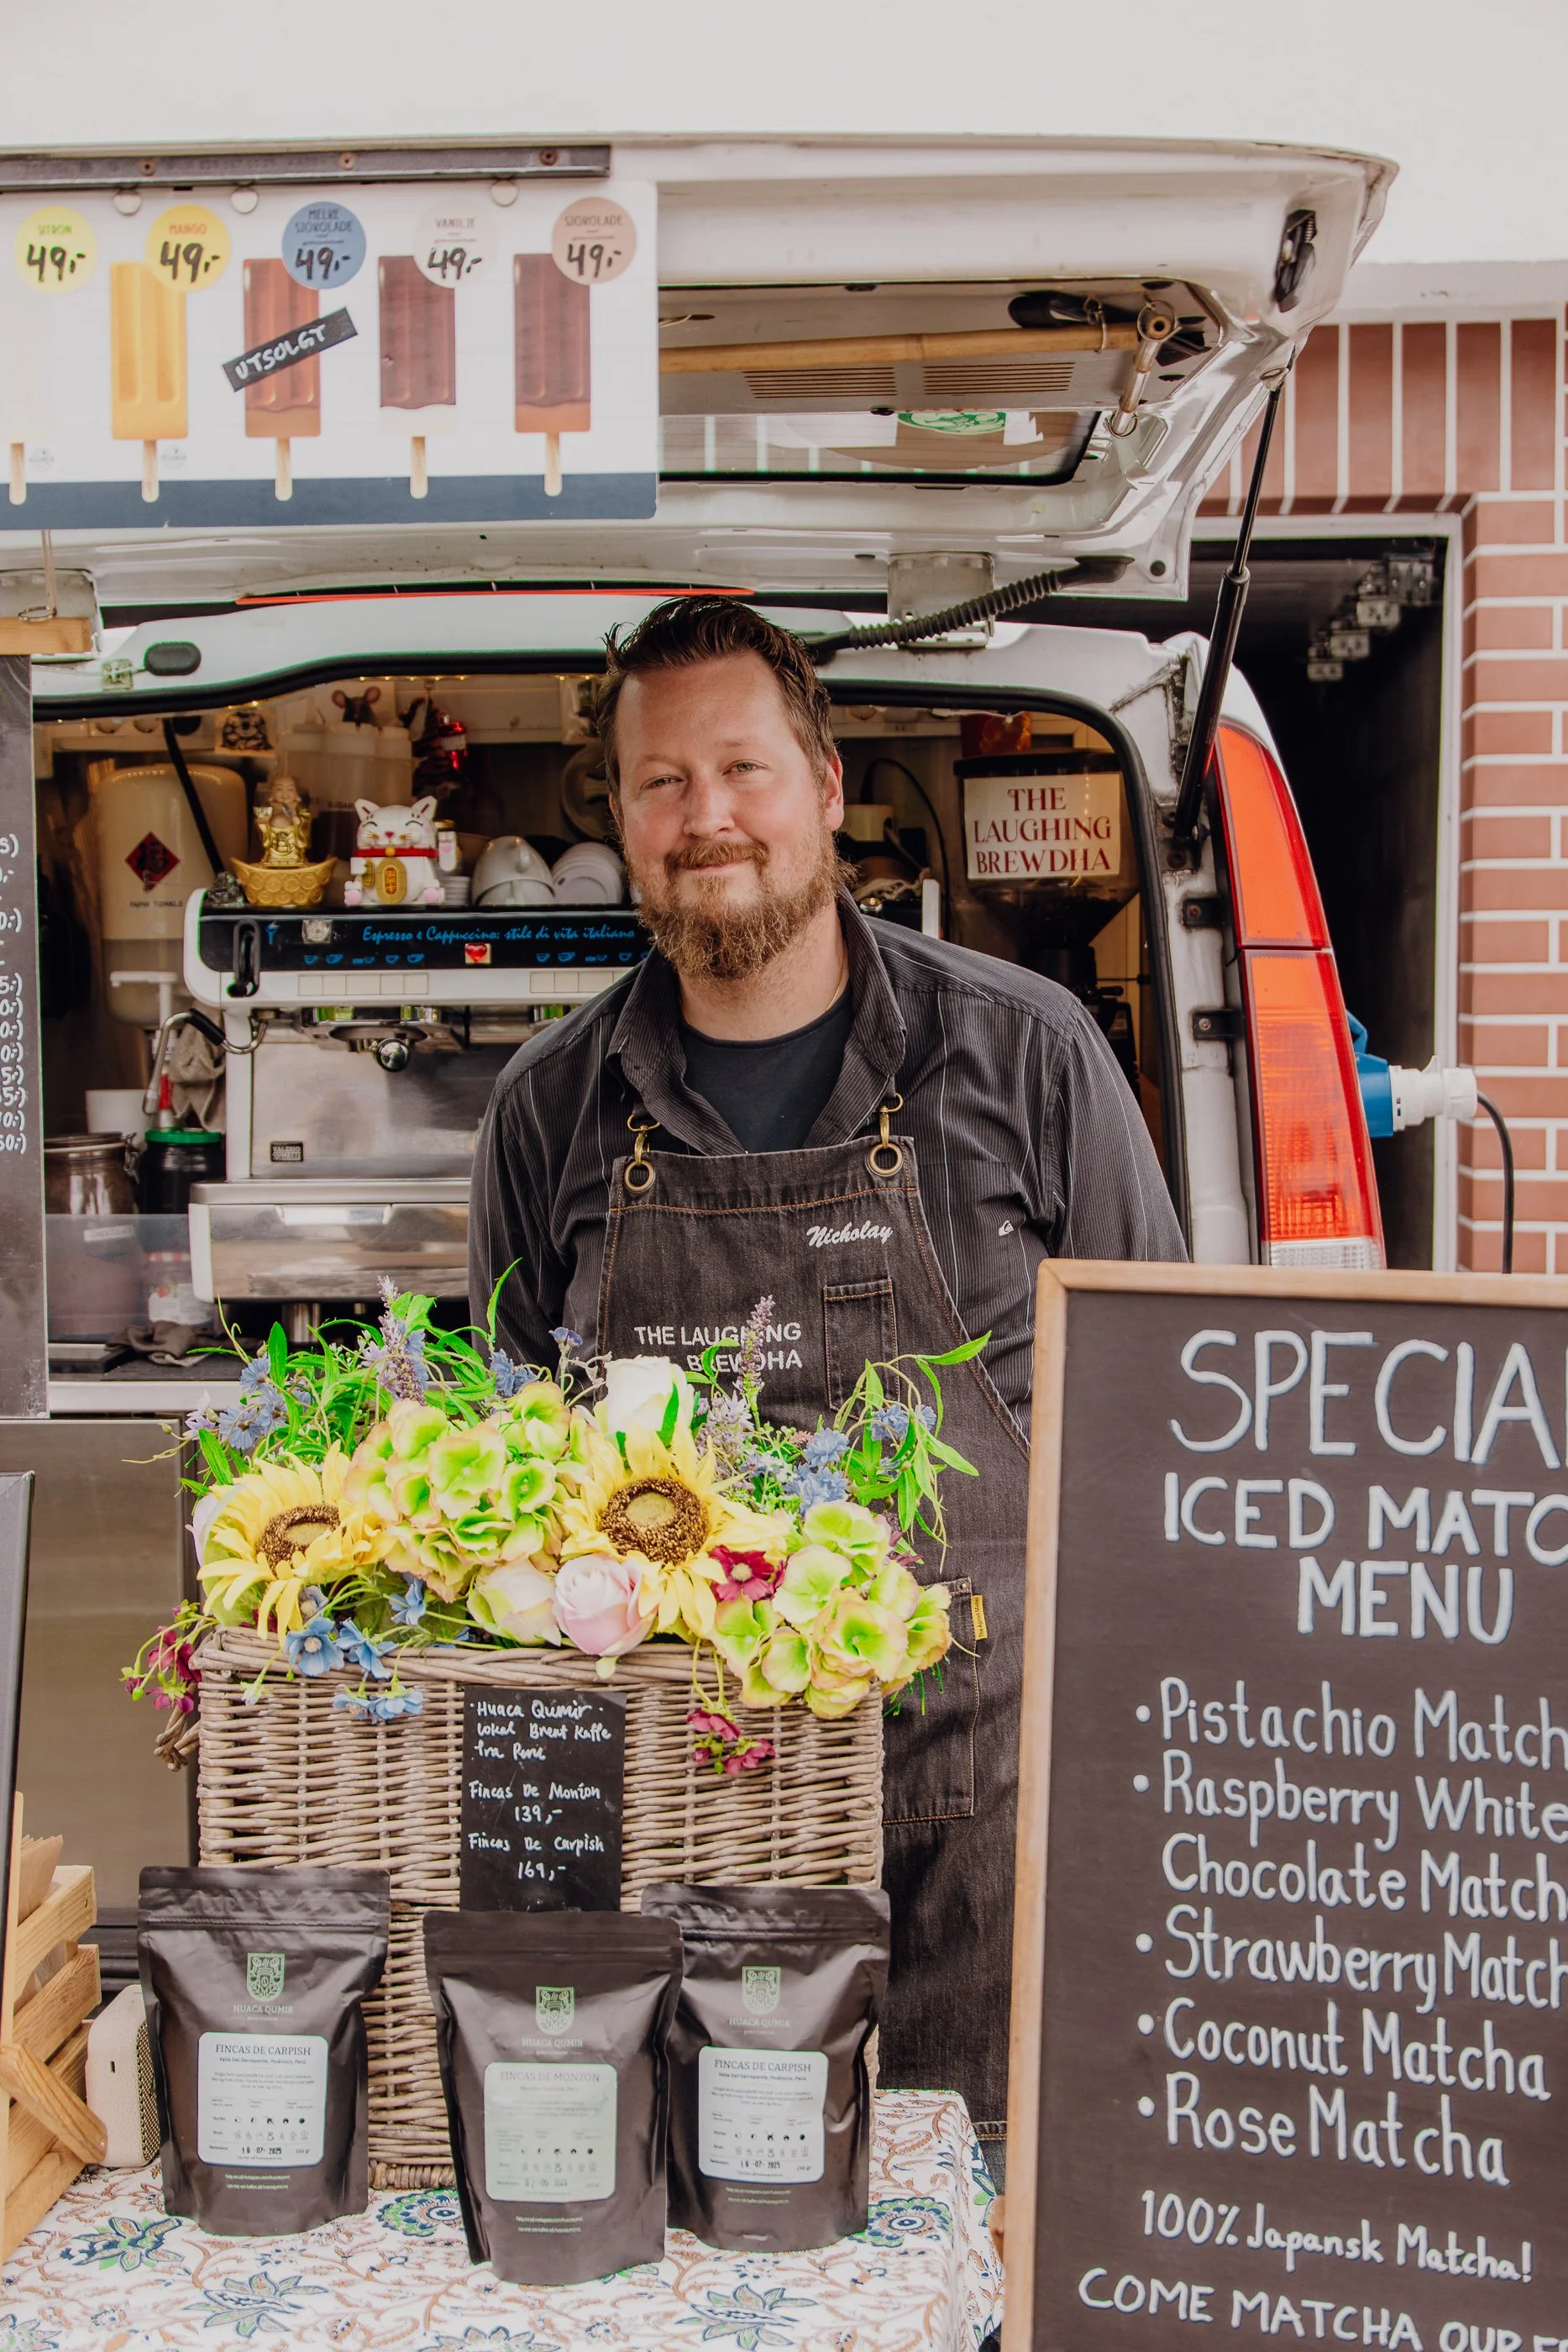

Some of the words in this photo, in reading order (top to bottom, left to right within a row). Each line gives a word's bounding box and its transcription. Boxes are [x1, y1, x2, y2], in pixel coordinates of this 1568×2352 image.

[168, 223, 207, 236] MANGO
[234, 323, 327, 381] UTSOLGT
[1007, 786, 1067, 812] THE
[973, 815, 1112, 844] LAUGHING
[975, 847, 1111, 875] BREWDHA
[363, 925, 413, 945] Espresso
[417, 930, 422, 942] e
[504, 924, 532, 942] stile
[535, 925, 550, 942] di
[553, 926, 579, 941] vita
[583, 924, 636, 941] italiano
[805, 1221, 894, 1249] Nicholay
[634, 1325, 675, 1346] THE
[1171, 1328, 1568, 1470] SPECIA
[1164, 1471, 1336, 1550] ICED
[1297, 1555, 1514, 1646] MENU
[476, 1700, 525, 1719] Huaca
[1160, 1676, 1398, 1758] Pistachio
[468, 1780, 514, 1800] Fincas
[522, 1782, 541, 1798] De
[1162, 1748, 1400, 1853] Raspberry
[1414, 1775, 1568, 1845] White
[467, 1831, 511, 1852] Fincas
[523, 1835, 543, 1851] De
[1161, 1832, 1408, 1912] Chocolate
[1164, 1903, 1437, 2015] Strawberry
[233, 2003, 264, 2014] HUACA
[264, 2004, 294, 2015] QUMIR
[729, 2016, 759, 2027] HUACA
[215, 2044, 250, 2055] FINCAS
[253, 2045, 266, 2055] DE
[268, 2045, 312, 2056] CARPISH
[521, 2037, 553, 2048] HUACA
[553, 2038, 584, 2049] QUMIR
[1163, 1997, 1349, 2076] Coconut
[1361, 2007, 1553, 2102] Matcha
[499, 2070, 536, 2082] FINCAS
[538, 2071, 553, 2082] DE
[714, 2058, 750, 2070] FINCAS
[753, 2061, 766, 2071] DE
[768, 2061, 812, 2072] CARPISH
[1166, 2071, 1297, 2158] Rose
[1308, 2083, 1511, 2187] Matcha
[1141, 2188, 1240, 2248] 100%
[1245, 2202, 1385, 2274] Japansk
[1396, 2221, 1534, 2284] Matcha!
[1078, 2266, 1215, 2324] COME
[1230, 2288, 1424, 2352] MATCHA
